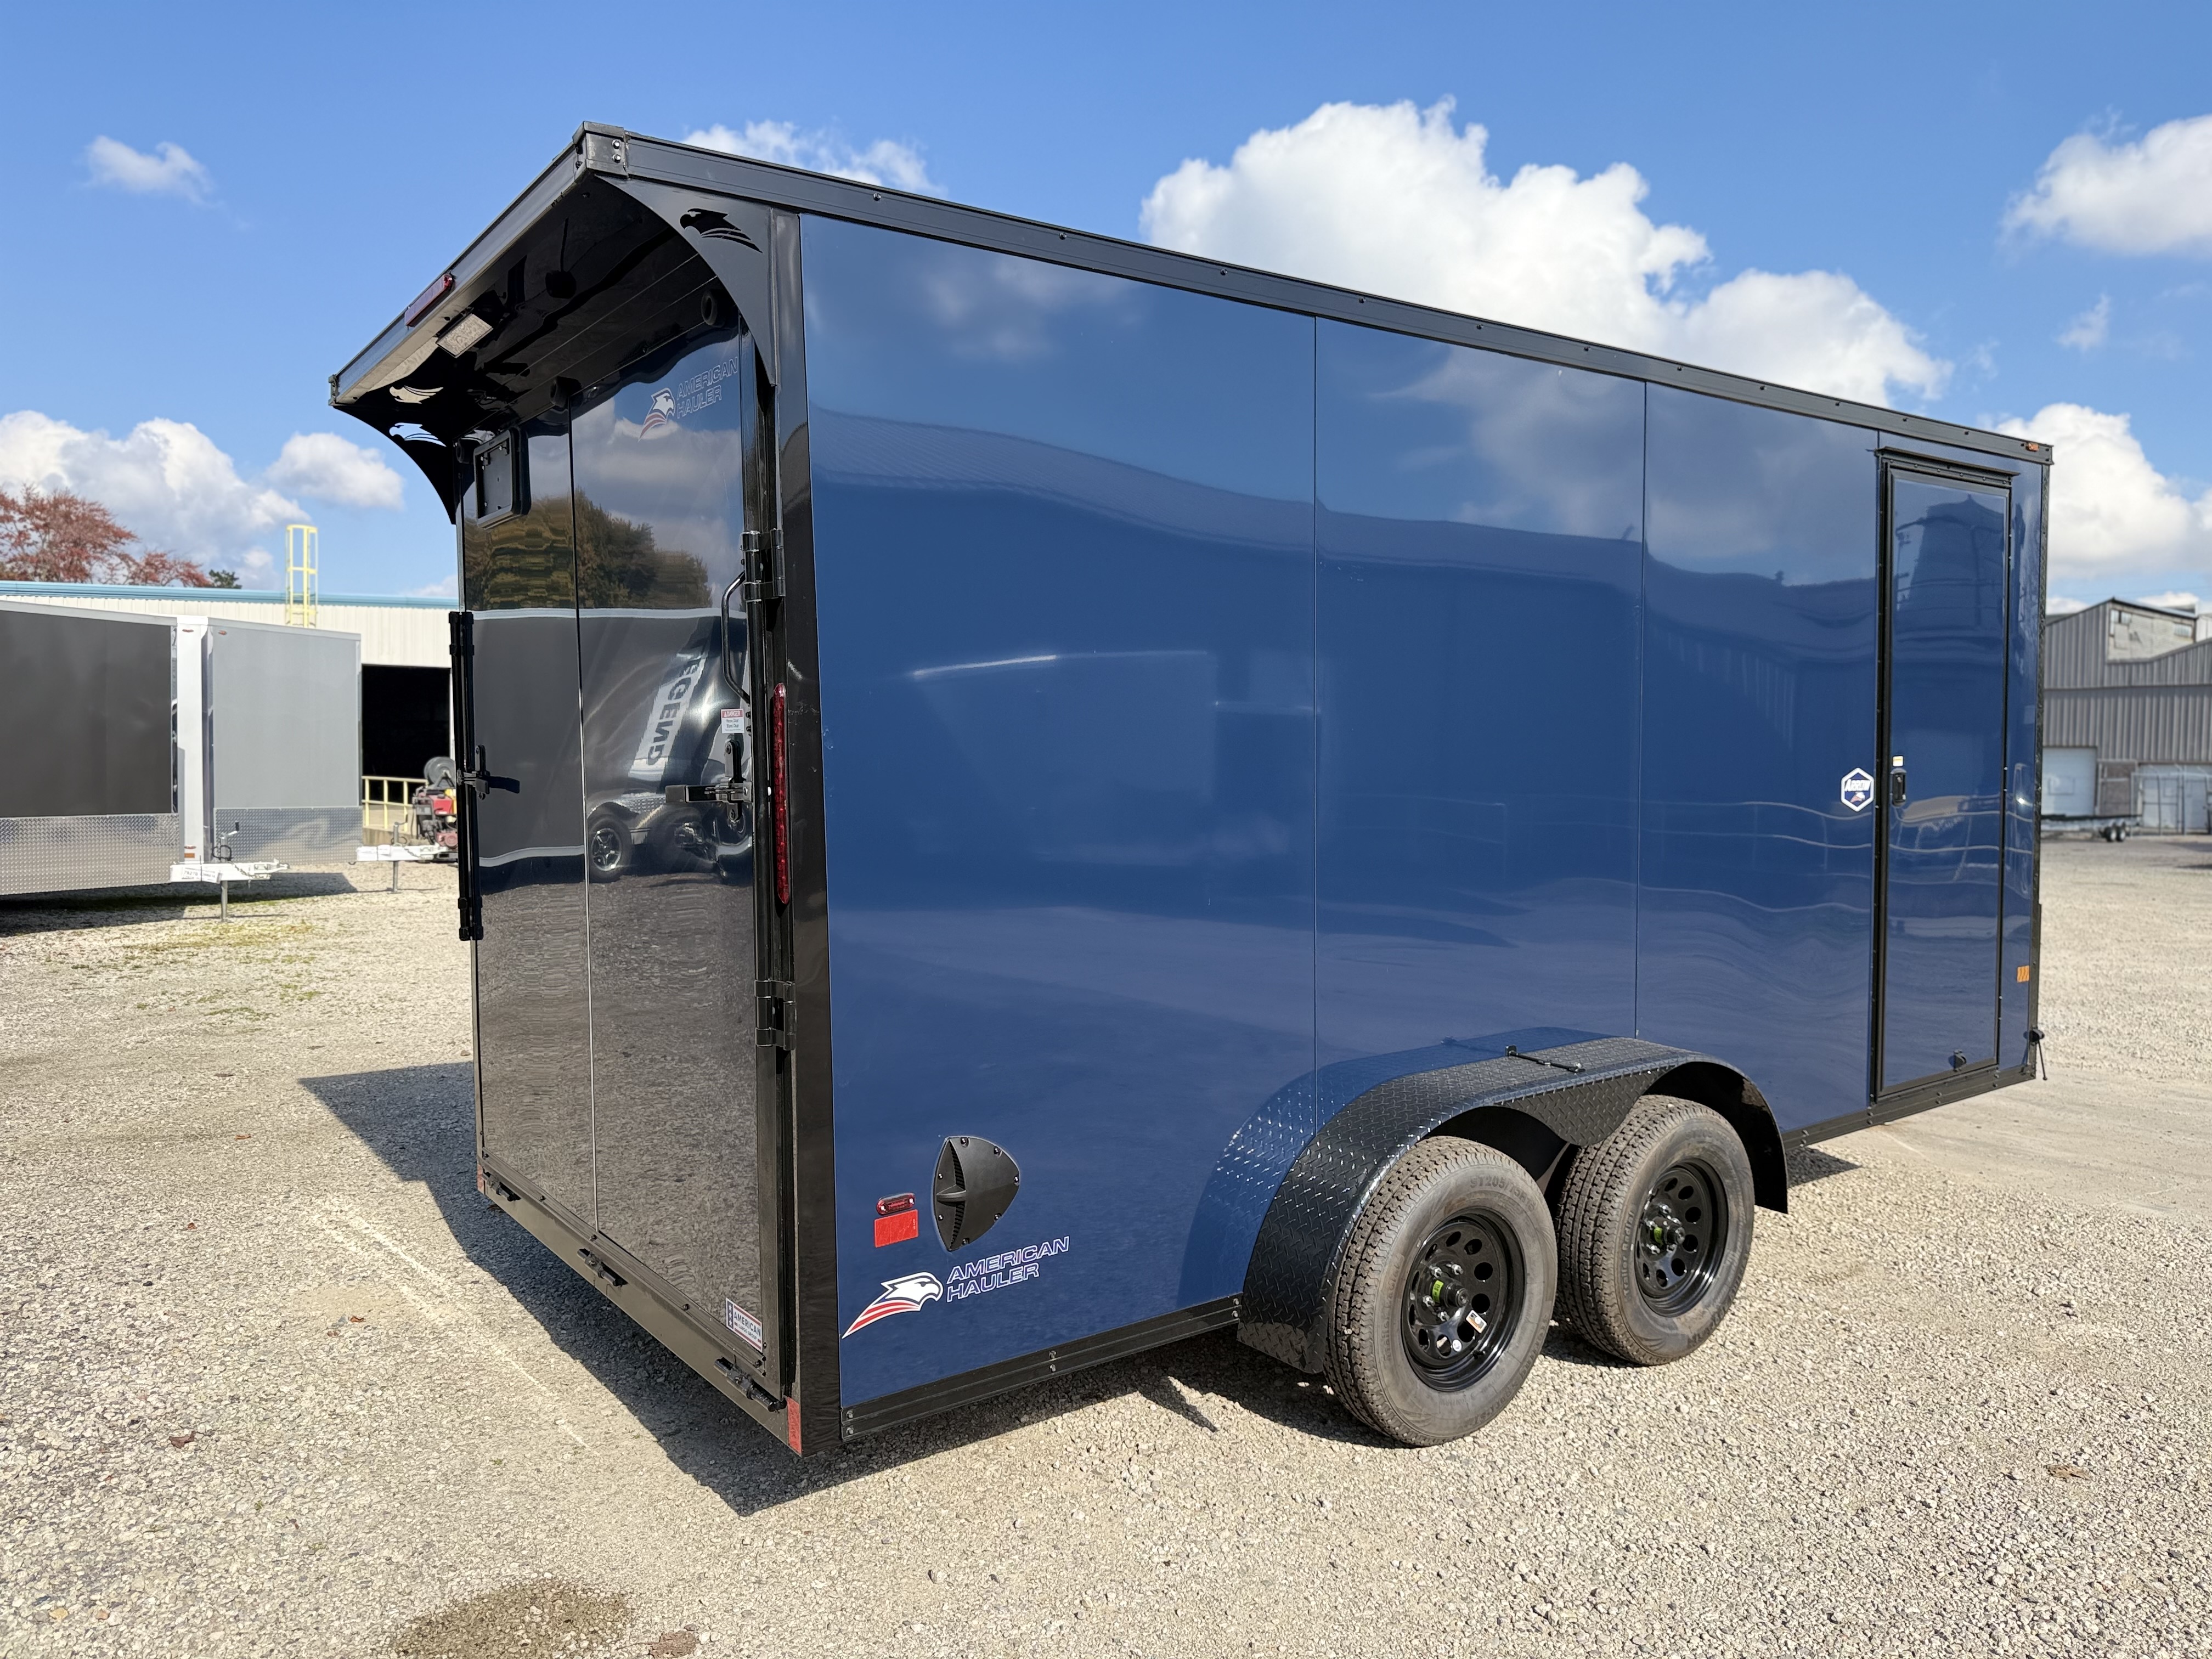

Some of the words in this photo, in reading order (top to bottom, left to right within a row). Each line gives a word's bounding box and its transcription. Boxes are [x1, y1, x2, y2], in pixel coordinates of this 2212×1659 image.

[676, 357, 738, 400] AMERICAN
[677, 385, 722, 419] HAULER
[947, 1236, 1070, 1285] AMERICAN
[947, 1262, 1040, 1303] HAULER
[734, 1312, 761, 1337] AMERICAN
